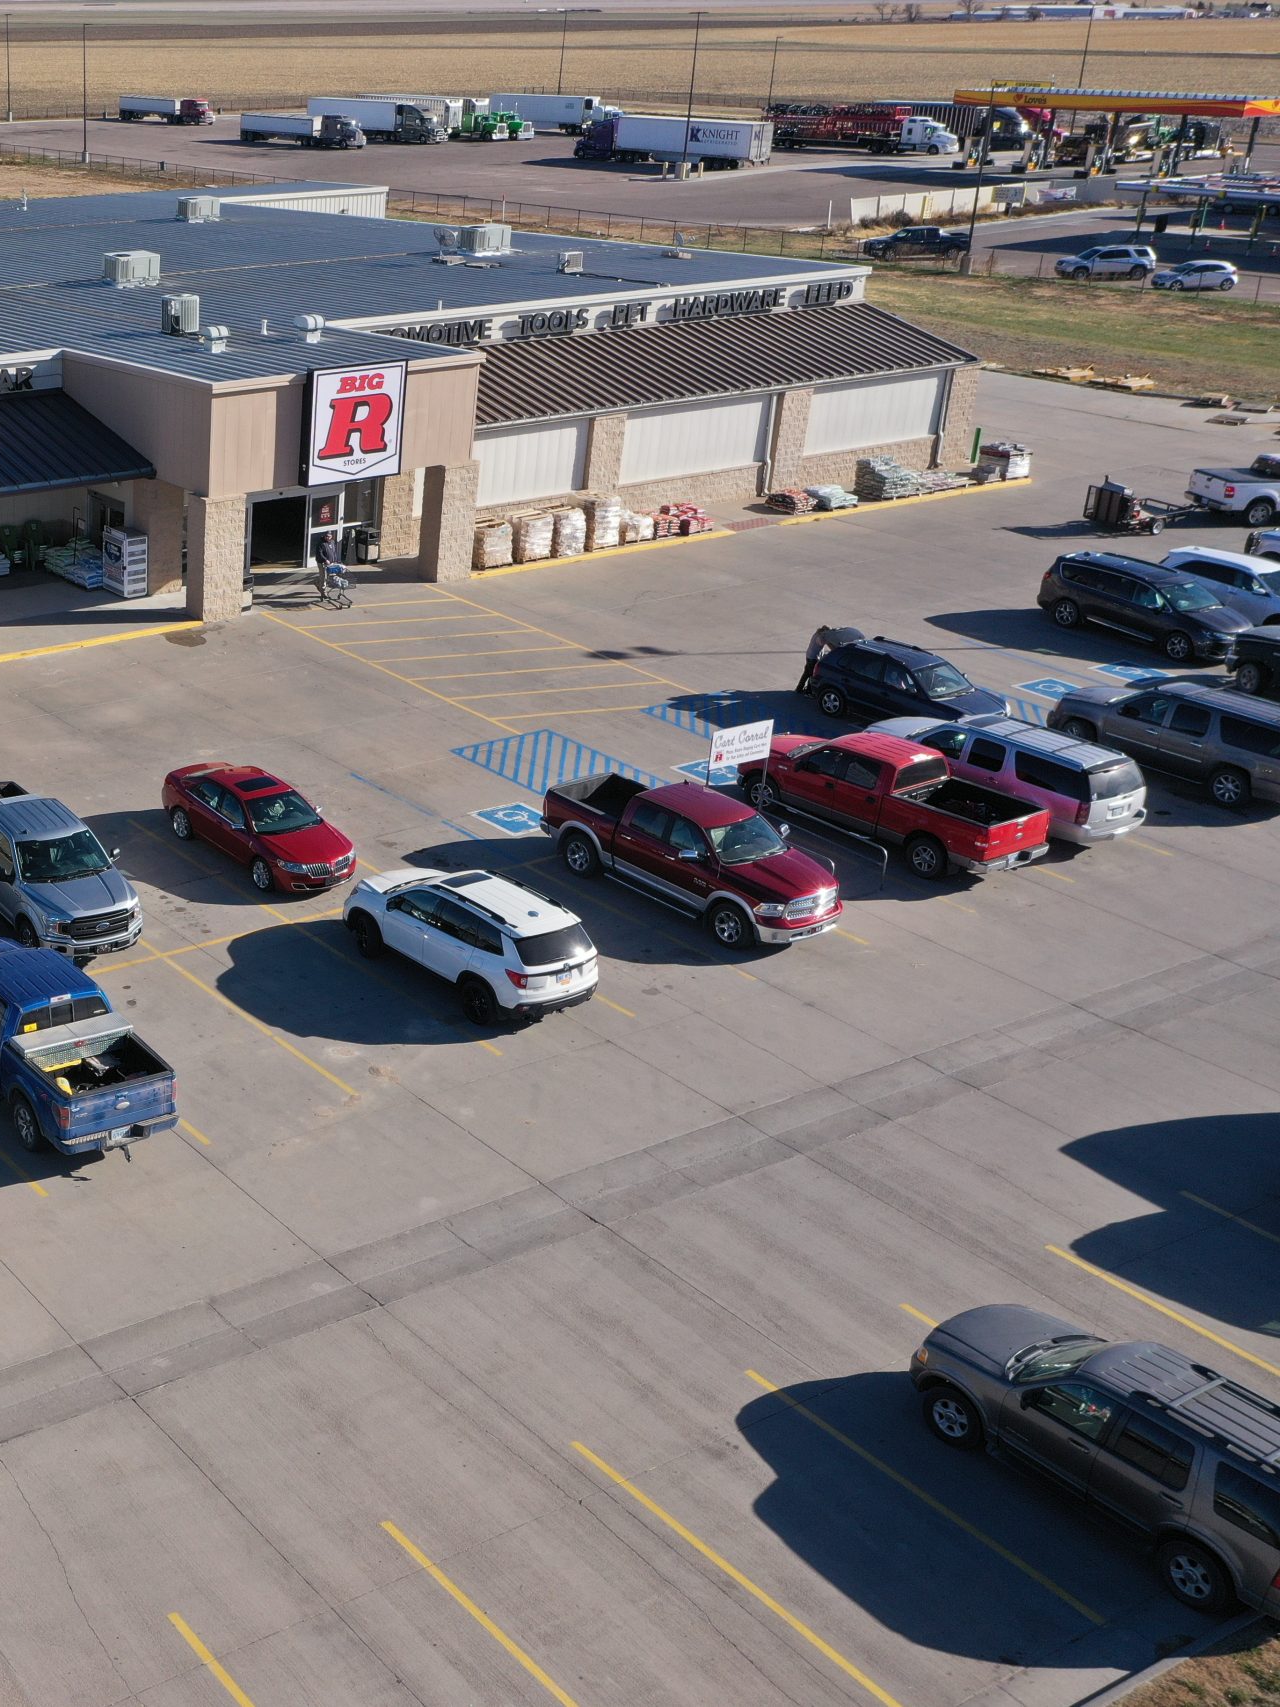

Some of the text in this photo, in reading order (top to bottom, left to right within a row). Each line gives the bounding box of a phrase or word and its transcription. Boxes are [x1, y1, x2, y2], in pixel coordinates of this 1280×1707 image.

[1024, 95, 1047, 104] Love's
[702, 127, 741, 141] KNIGHT
[517, 308, 589, 336] TOOLS
[610, 302, 652, 326] PET
[672, 287, 788, 319] HARDWARE
[805, 281, 854, 305] FEED
[336, 373, 385, 394] BIG
[317, 393, 393, 461] R
[343, 457, 367, 467] STORES
[714, 735, 736, 750] Cart
[738, 726, 770, 744] Corral
